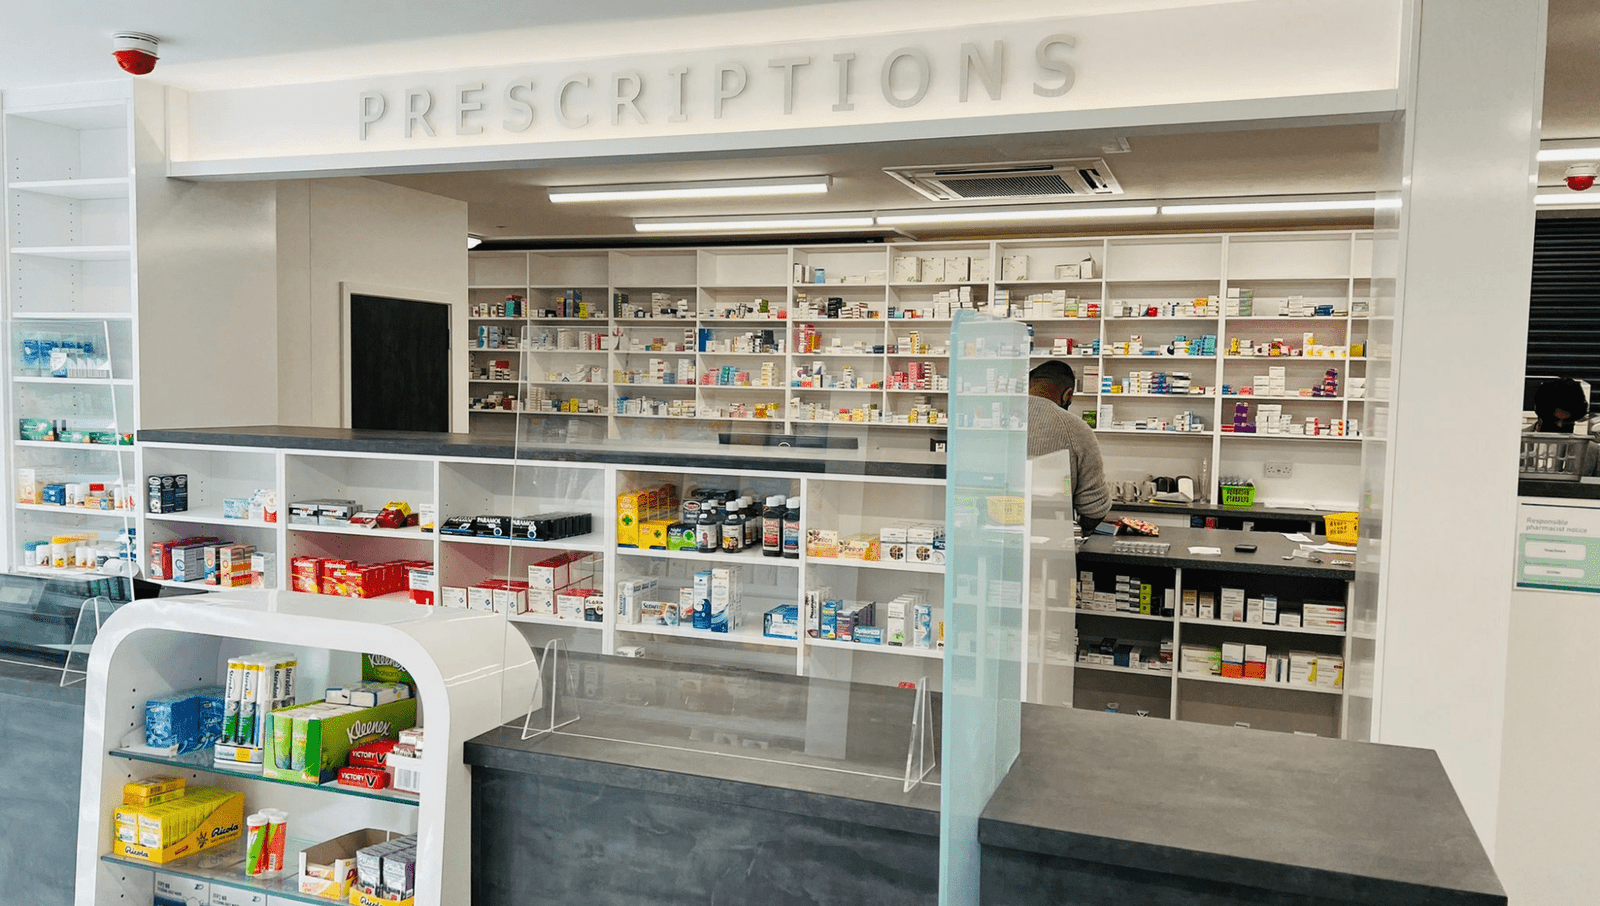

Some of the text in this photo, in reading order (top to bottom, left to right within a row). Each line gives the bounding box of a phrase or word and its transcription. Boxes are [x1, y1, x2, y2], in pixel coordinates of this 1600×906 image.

[358, 34, 1078, 141] PRESCRIPTIONS
[476, 517, 501, 525] PARAMOL
[1526, 517, 1569, 526] Responsible
[1525, 525, 1565, 533] pharmacist
[368, 654, 406, 672] Kleenex
[272, 670, 280, 699] Steradent
[346, 720, 392, 745] Kleenex
[352, 750, 387, 764] VICTORY V
[341, 772, 378, 787] VICTORY V
[211, 823, 239, 838] Ricola
[124, 845, 149, 858] Ricola
